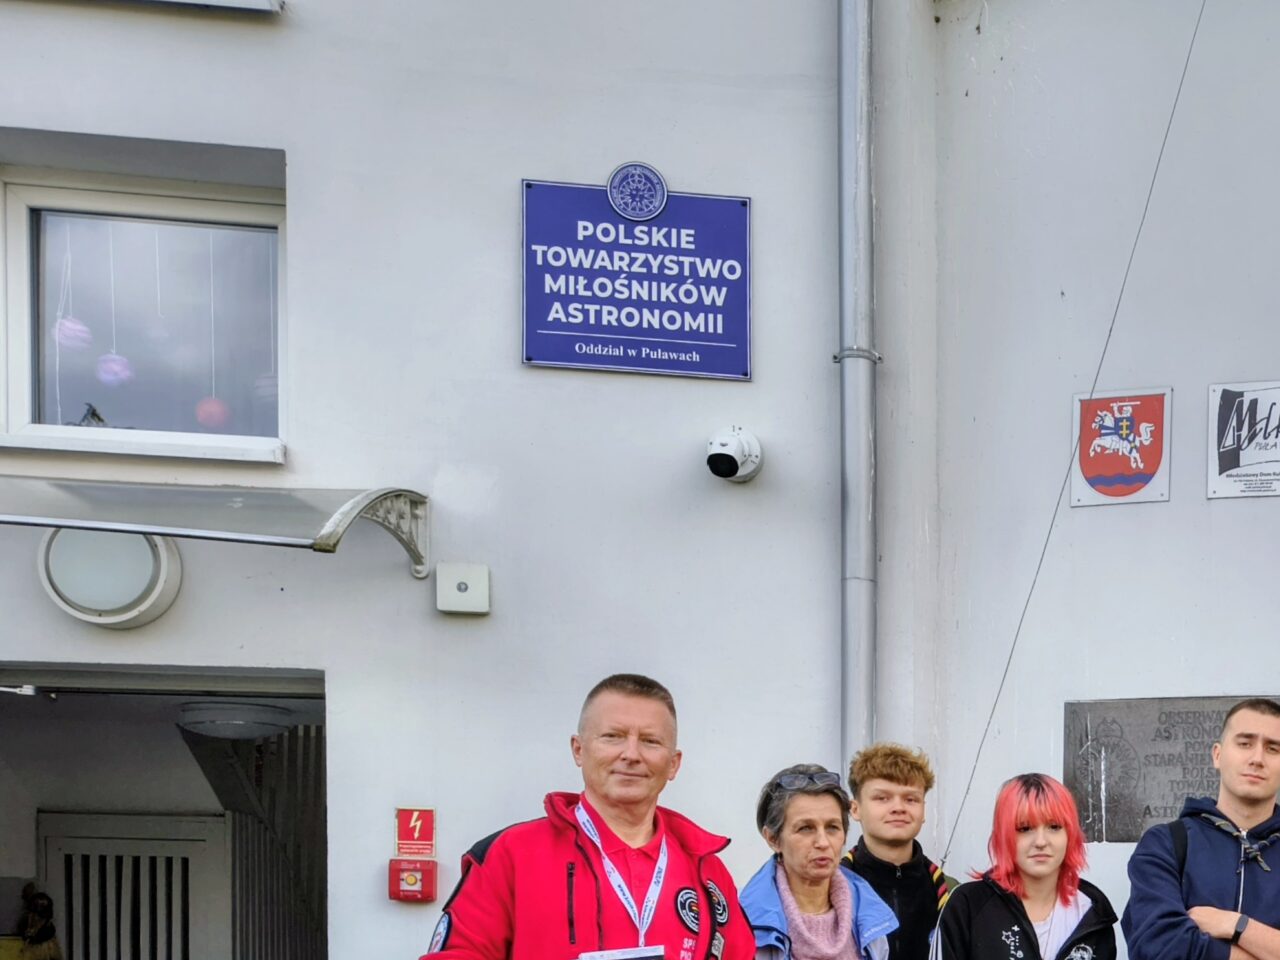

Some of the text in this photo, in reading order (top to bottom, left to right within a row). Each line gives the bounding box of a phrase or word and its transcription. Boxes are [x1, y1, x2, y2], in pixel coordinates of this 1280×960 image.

[576, 220, 696, 250] POLSKIE
[531, 244, 742, 280] TOWARZYSTWO
[544, 273, 728, 307] MIŁOŚNIKÓW
[547, 301, 724, 334] ASTRONOMII
[574, 342, 701, 362] Oddział w Puławach
